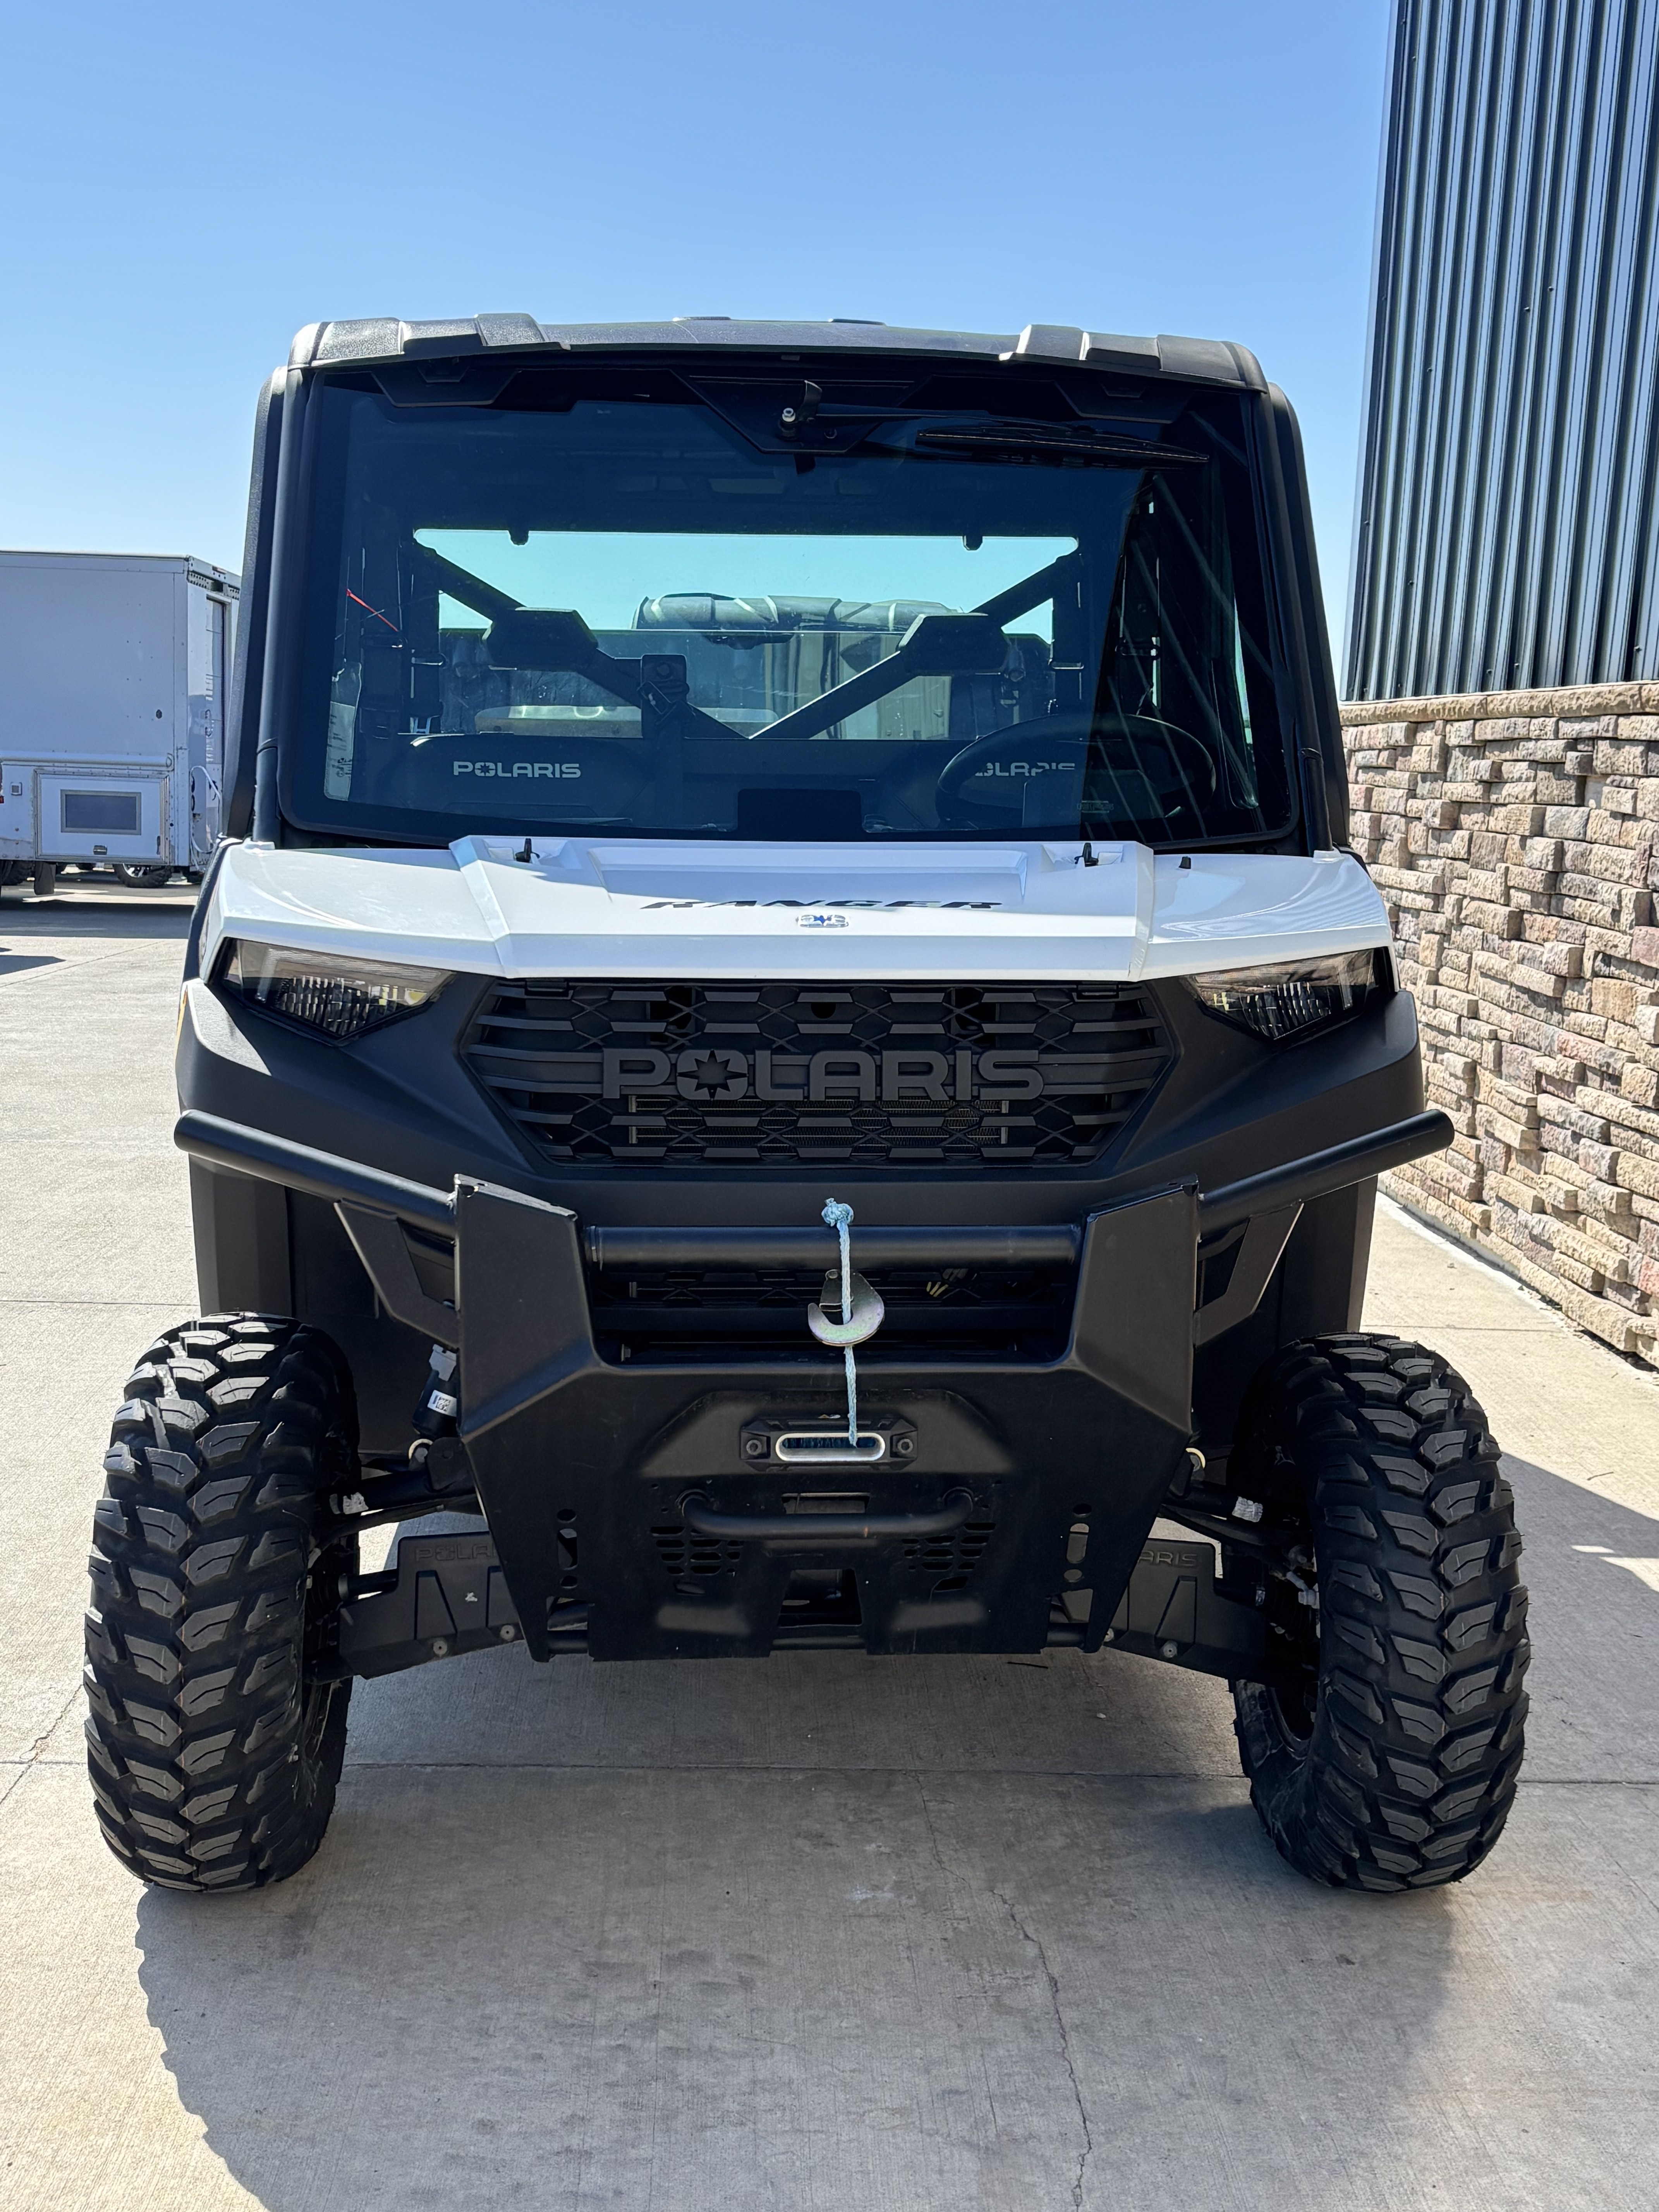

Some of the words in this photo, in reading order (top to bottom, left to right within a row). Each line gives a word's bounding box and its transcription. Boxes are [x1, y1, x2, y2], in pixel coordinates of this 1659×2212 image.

[453, 761, 581, 778] POLARIS
[640, 900, 1002, 908] RANGER
[603, 1048, 1044, 1101] POLARIS
[416, 1543, 495, 1561] POLA
[1138, 1551, 1197, 1566] ARIS
